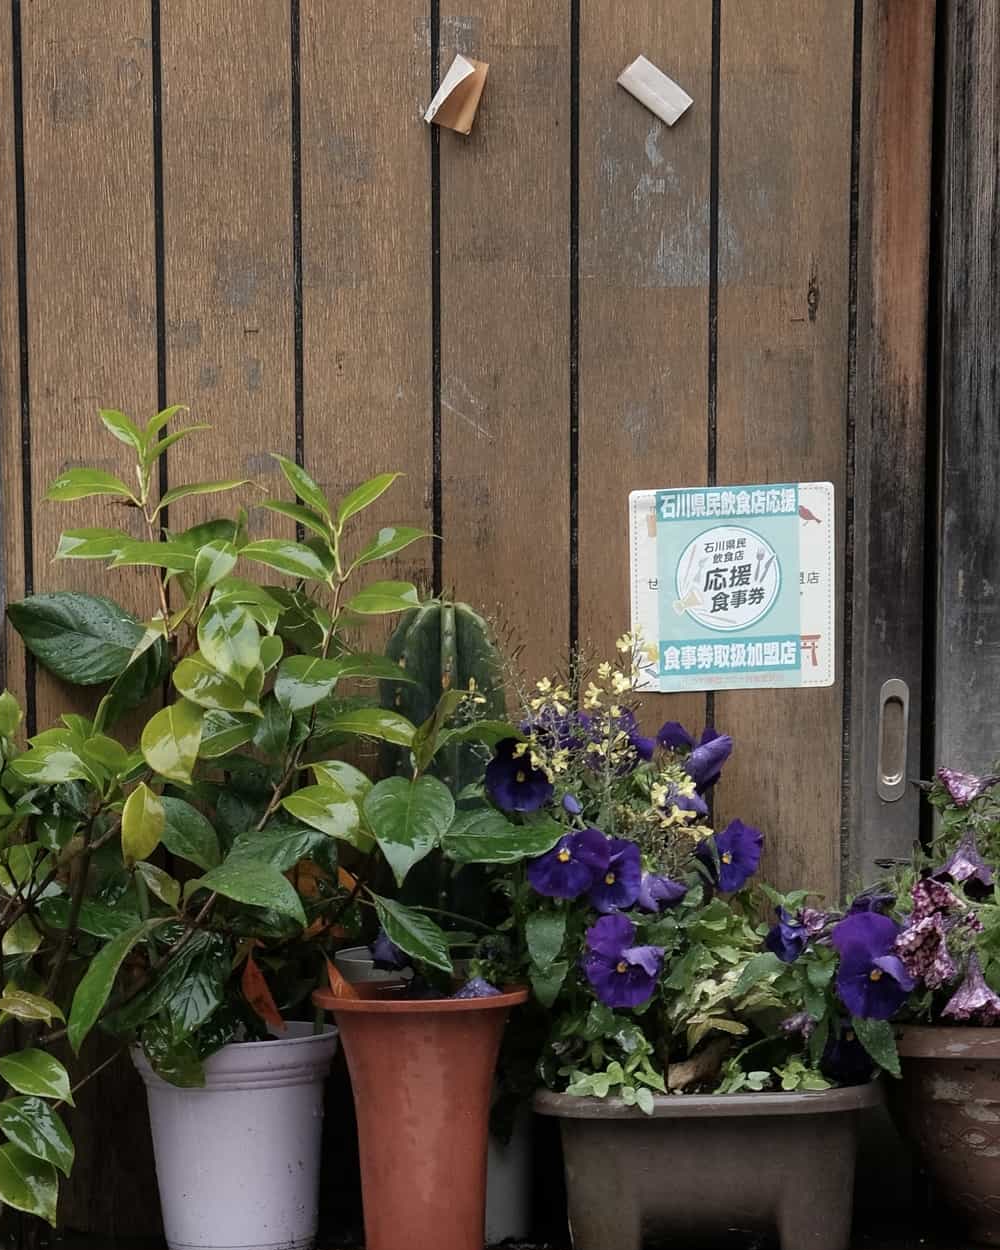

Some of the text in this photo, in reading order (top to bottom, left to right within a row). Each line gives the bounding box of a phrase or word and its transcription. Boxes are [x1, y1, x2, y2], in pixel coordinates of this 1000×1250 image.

[660, 488, 796, 518] 石川県民飲食店応援
[704, 538, 746, 553] 石川県民
[713, 550, 744, 564] 飲食店
[703, 563, 752, 592] 応援
[710, 587, 765, 613] 食事券
[663, 641, 797, 671] 食事券取扱加盟店
